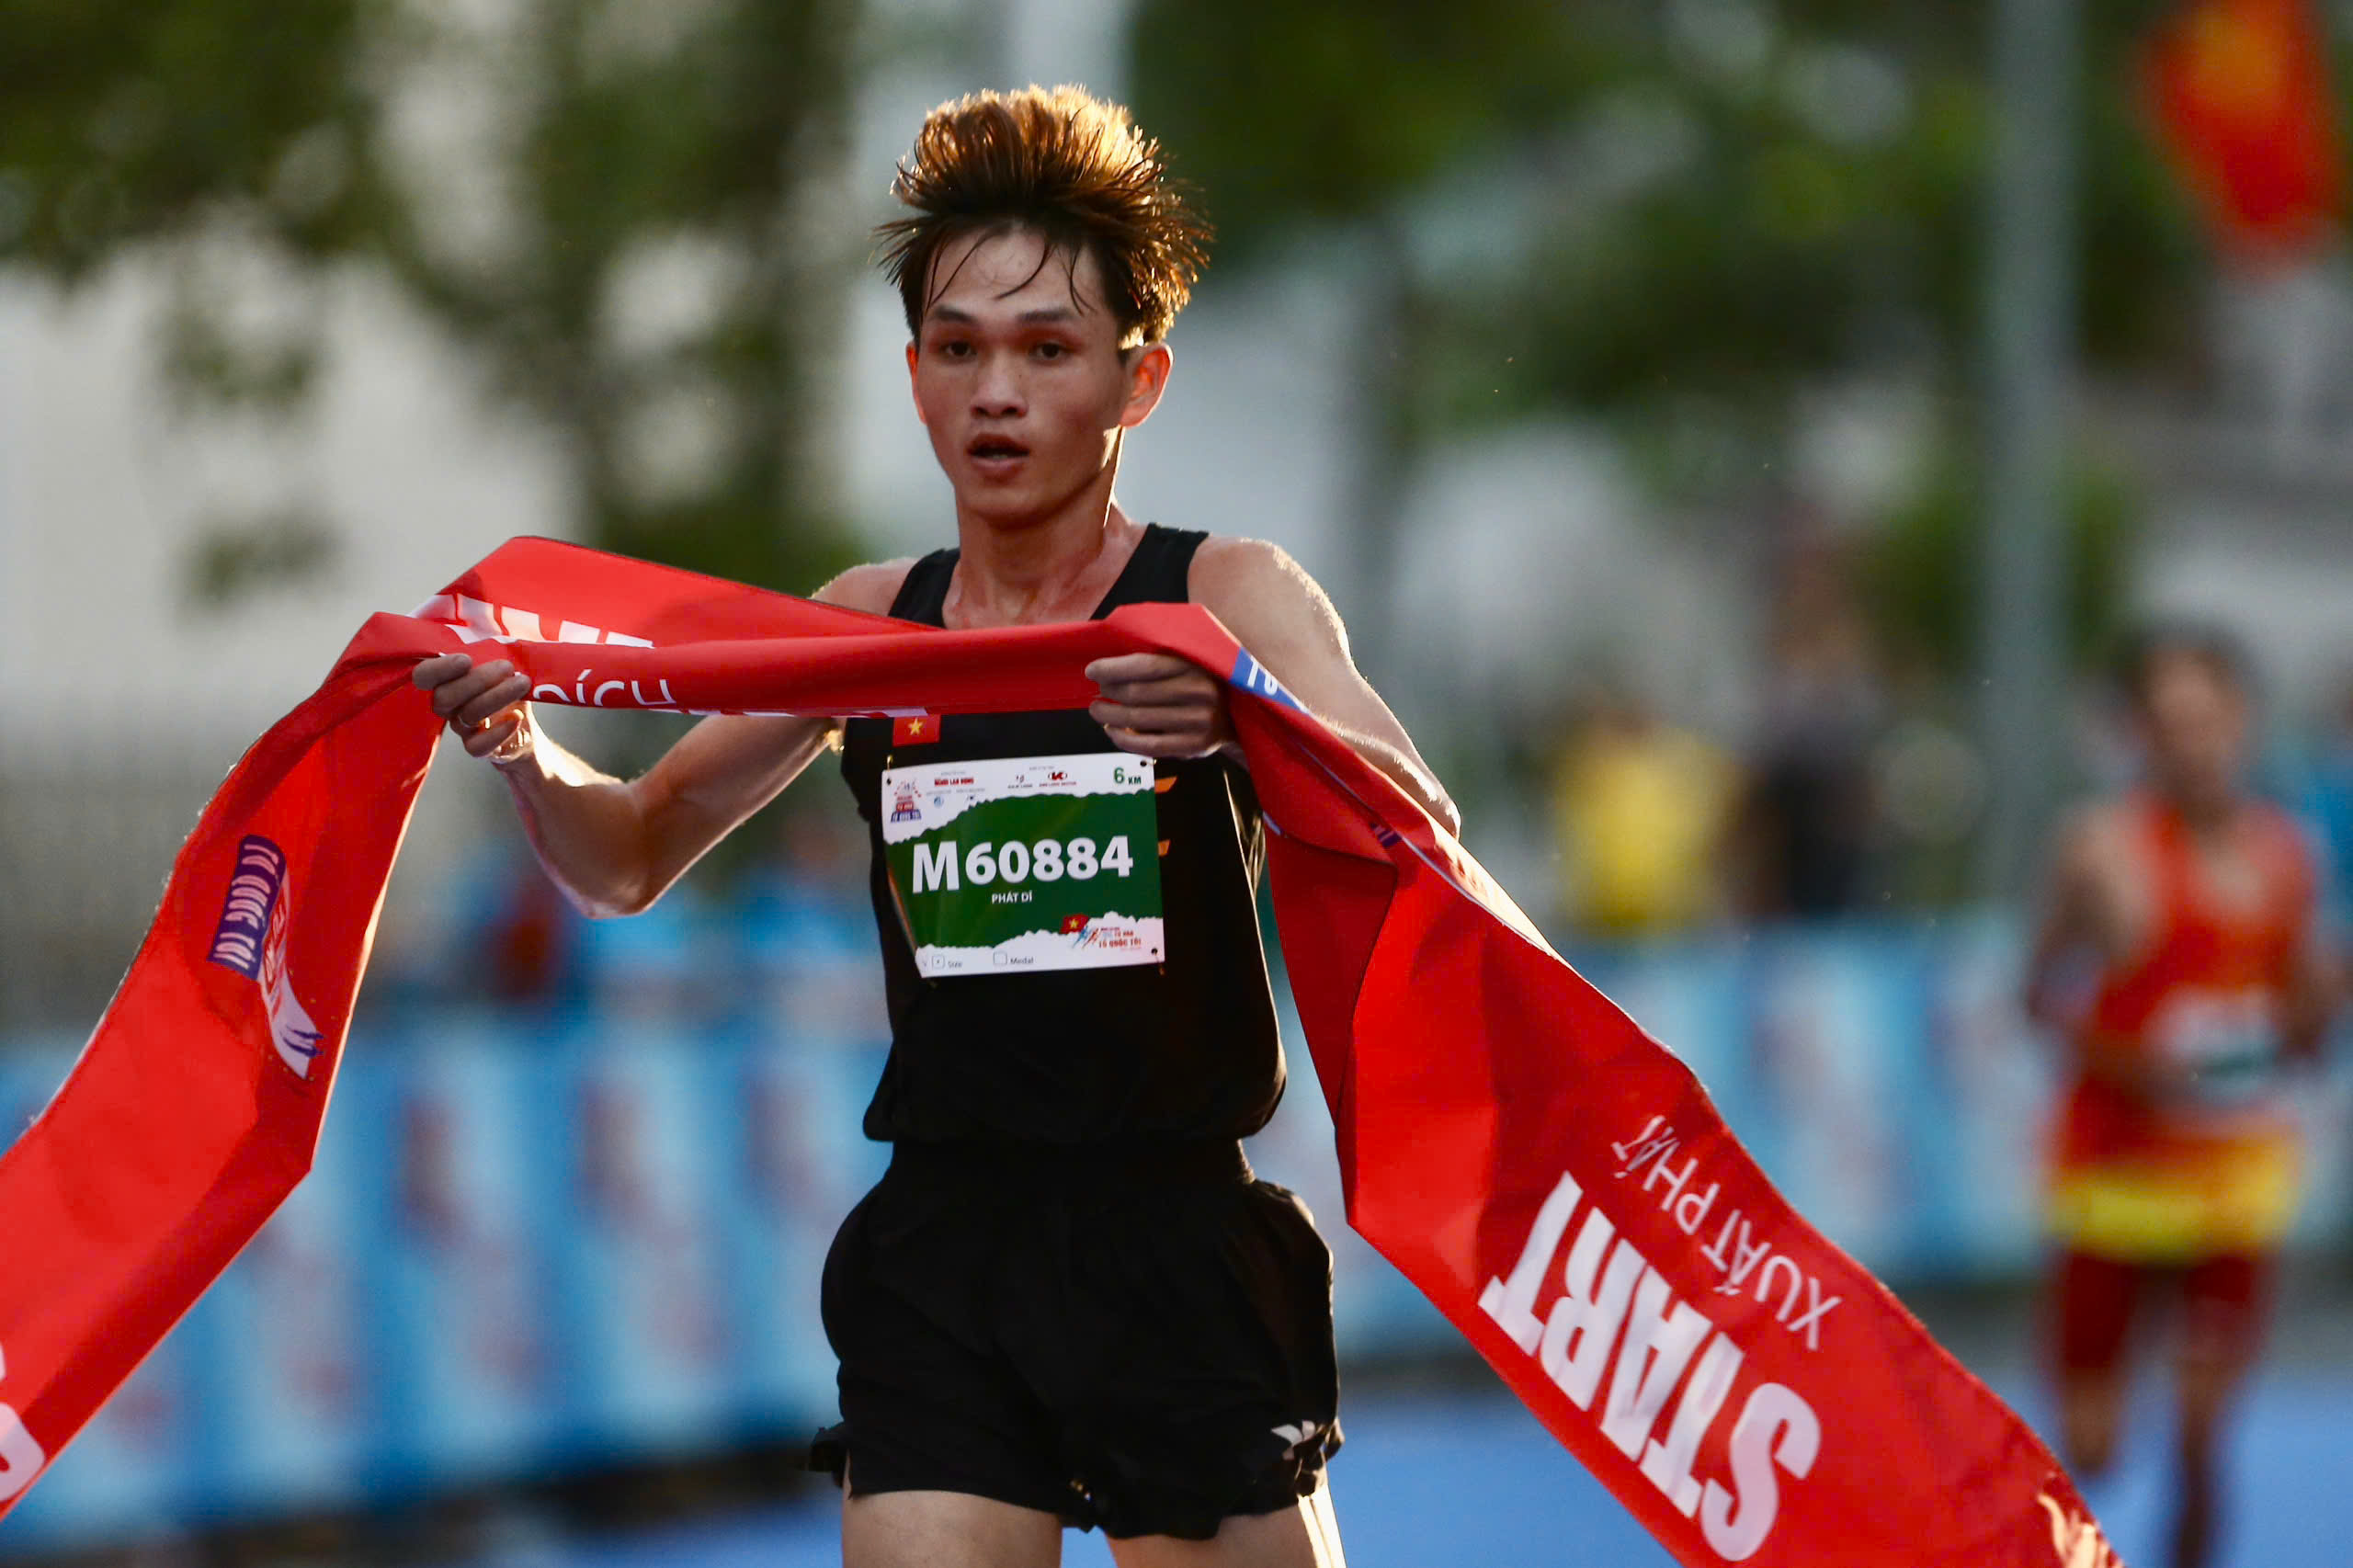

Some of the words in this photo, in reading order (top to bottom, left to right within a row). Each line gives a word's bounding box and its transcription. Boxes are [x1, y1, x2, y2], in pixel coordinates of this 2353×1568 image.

[1114, 767, 1125, 784] 6
[1128, 776, 1142, 786] KM
[912, 835, 1134, 894] M60884
[1477, 1170, 1822, 1562] START
